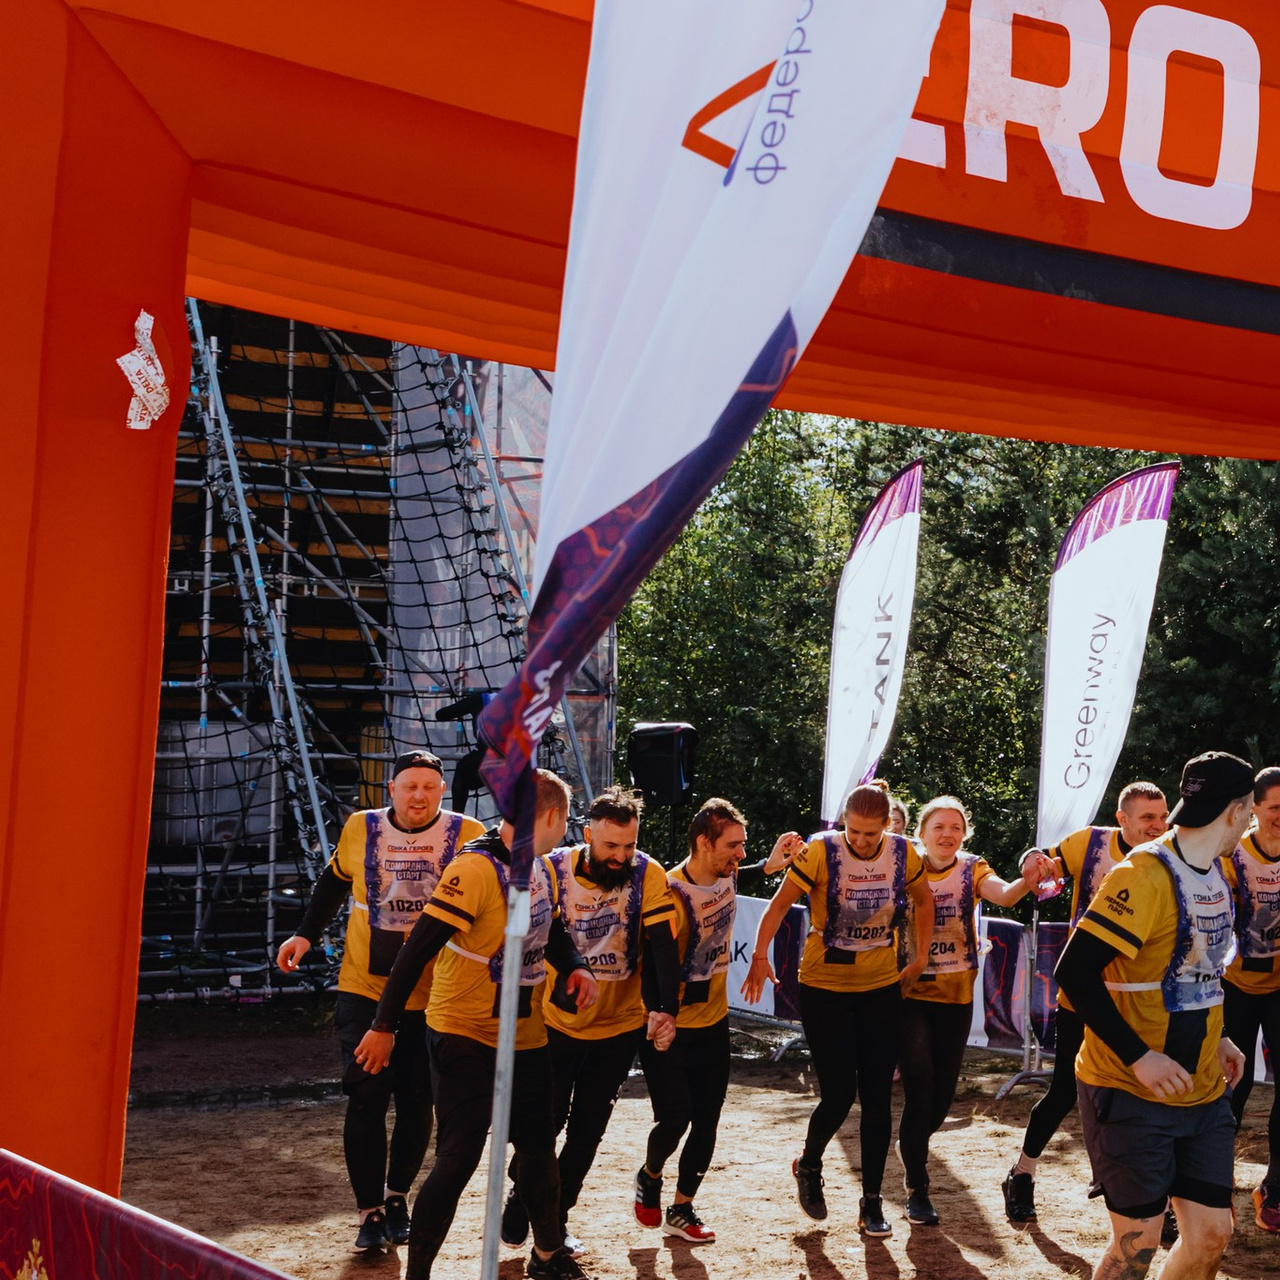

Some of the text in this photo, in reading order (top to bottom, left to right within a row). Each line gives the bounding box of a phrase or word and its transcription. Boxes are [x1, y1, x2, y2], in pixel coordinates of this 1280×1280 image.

[868, 592, 894, 742] TANK
[1064, 613, 1116, 790] Greenway
[397, 871, 420, 880] СТАРТ
[388, 900, 428, 912] 1020
[1107, 904, 1123, 916] ПРО
[929, 942, 956, 956] 204
